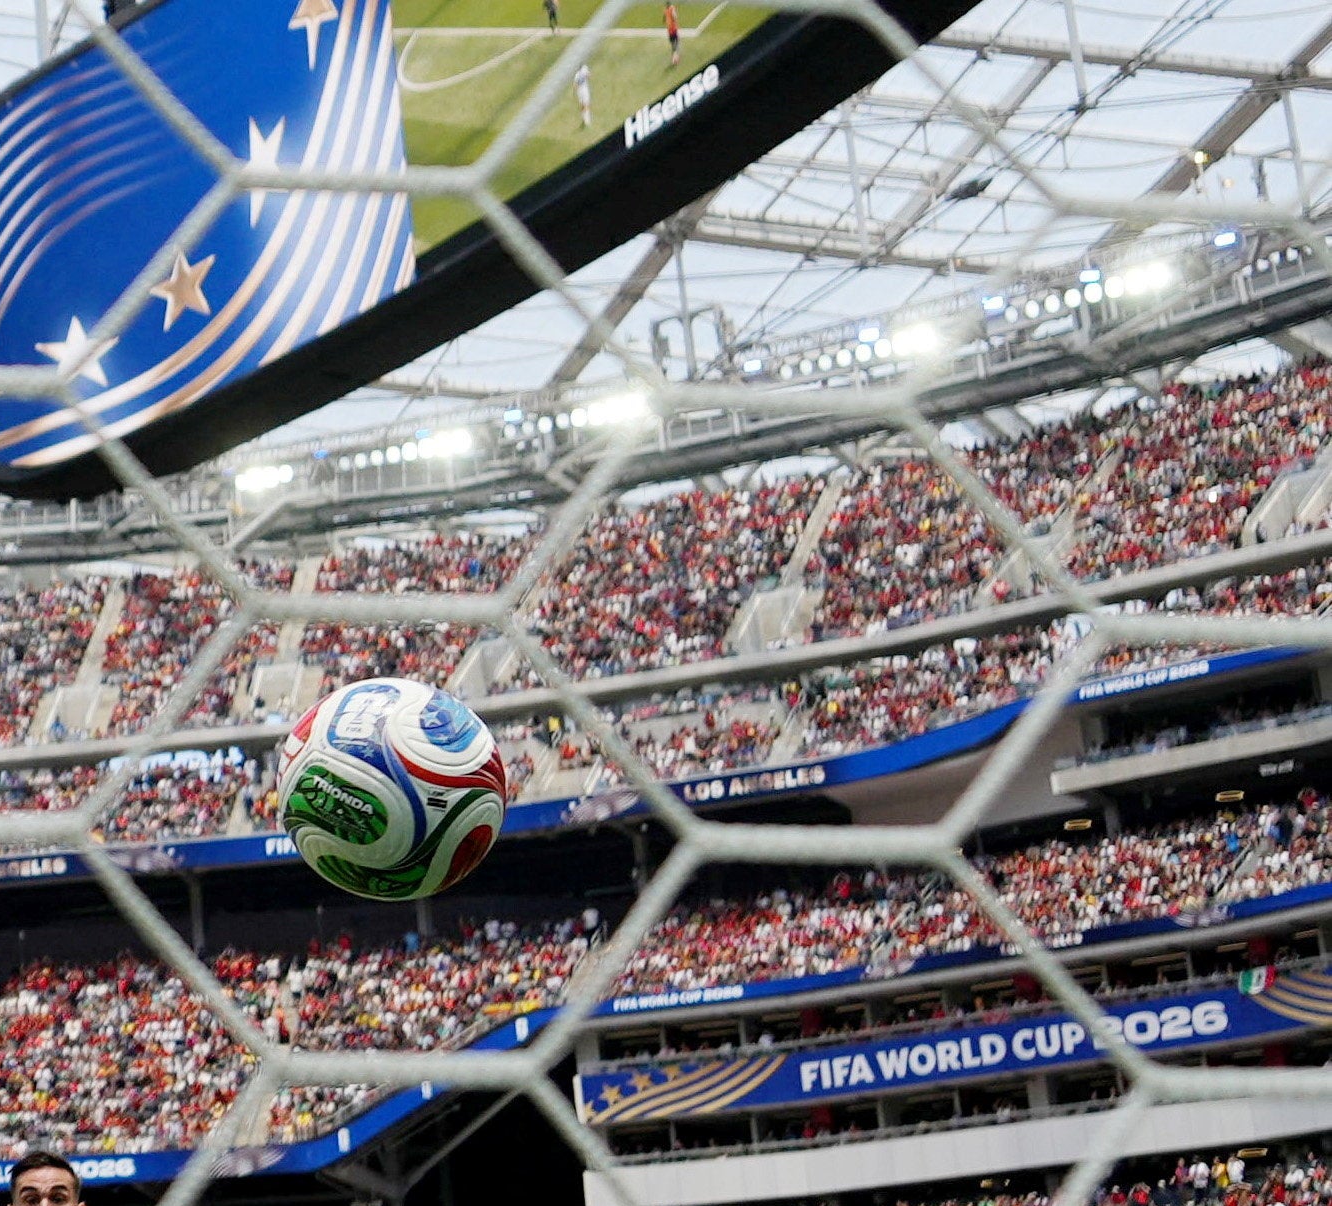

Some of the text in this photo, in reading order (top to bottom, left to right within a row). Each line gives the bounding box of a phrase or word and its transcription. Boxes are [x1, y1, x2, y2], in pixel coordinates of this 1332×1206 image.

[624, 63, 720, 149] Hisense
[313, 774, 374, 815] TRIONDA
[683, 779, 724, 802] LOS
[799, 1053, 876, 1093] FIFA
[876, 1033, 1007, 1081] WORLD
[1011, 1021, 1086, 1062] CUP
